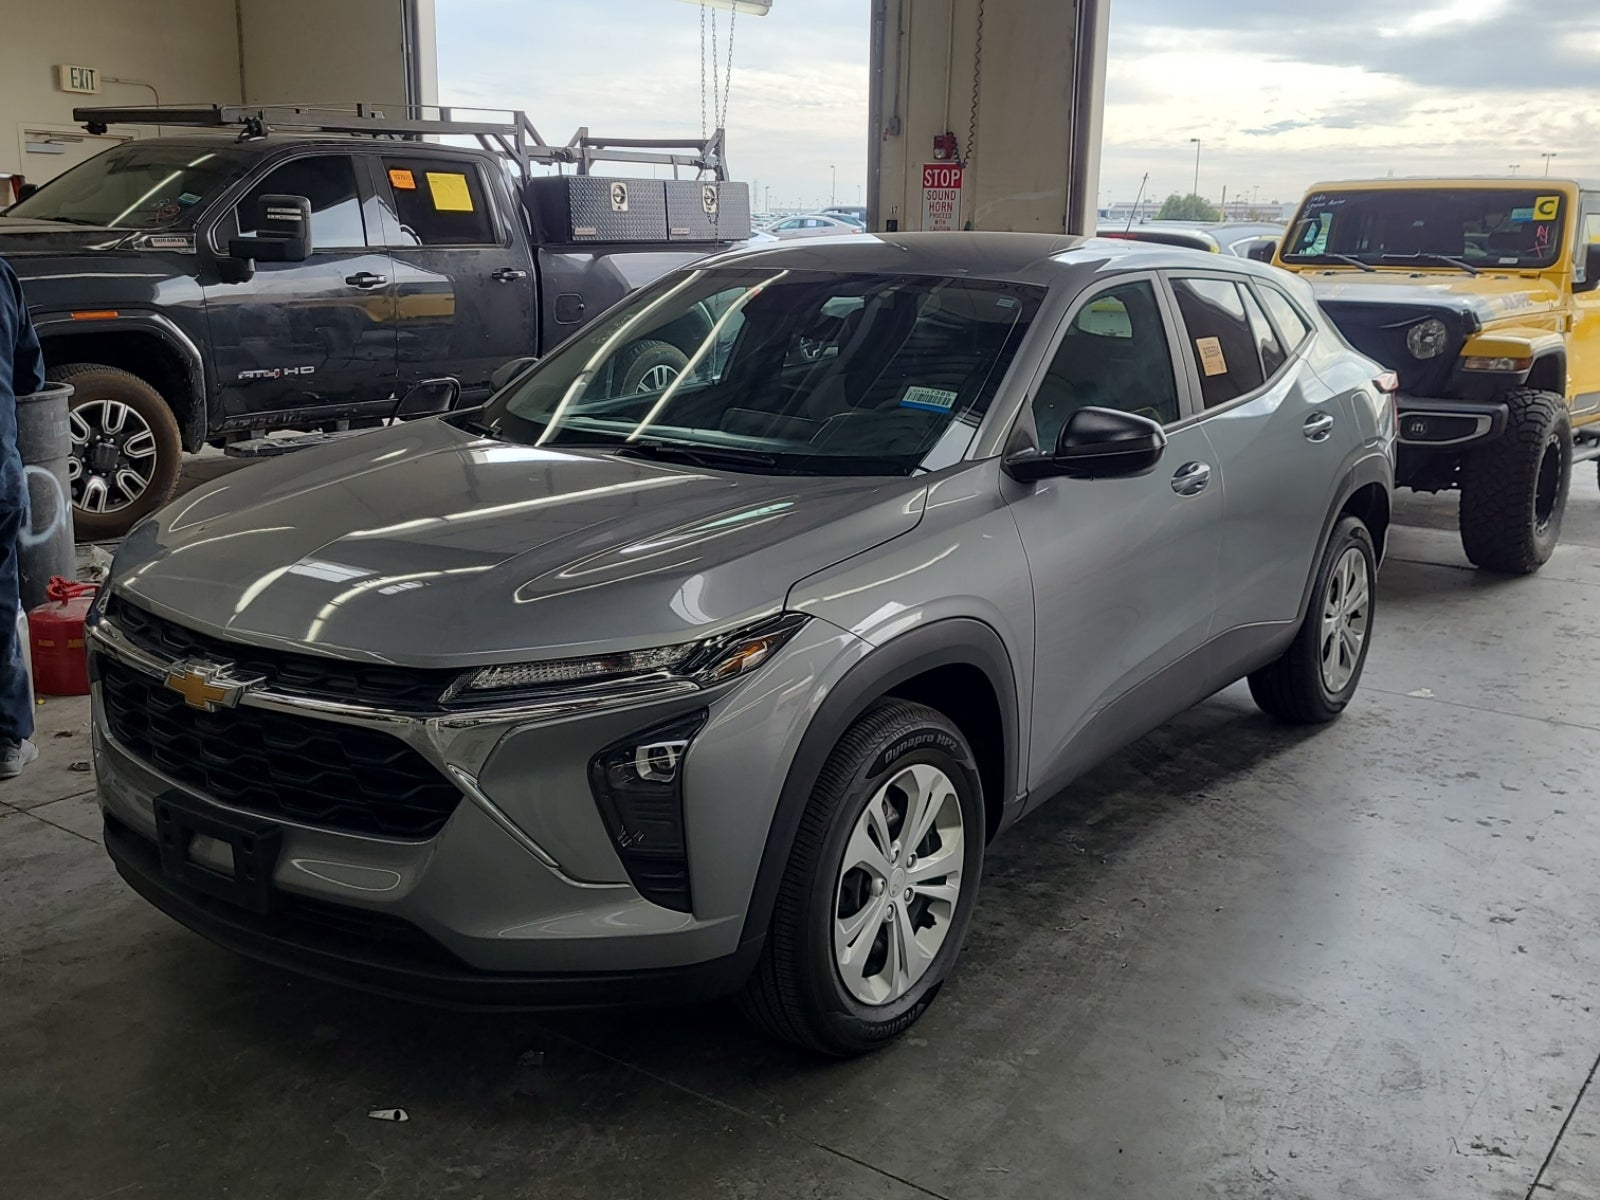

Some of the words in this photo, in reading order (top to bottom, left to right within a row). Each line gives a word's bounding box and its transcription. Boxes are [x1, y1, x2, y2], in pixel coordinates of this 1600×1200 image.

[70, 67, 96, 91] EXIT
[924, 168, 961, 187] STOP
[926, 189, 957, 201] SOUND
[928, 201, 953, 213] HORN
[1538, 200, 1556, 215] C
[928, 212, 952, 220] PROCEED
[284, 365, 315, 376] HD
[884, 733, 934, 765] Dynapro
[936, 733, 958, 752] HP2
